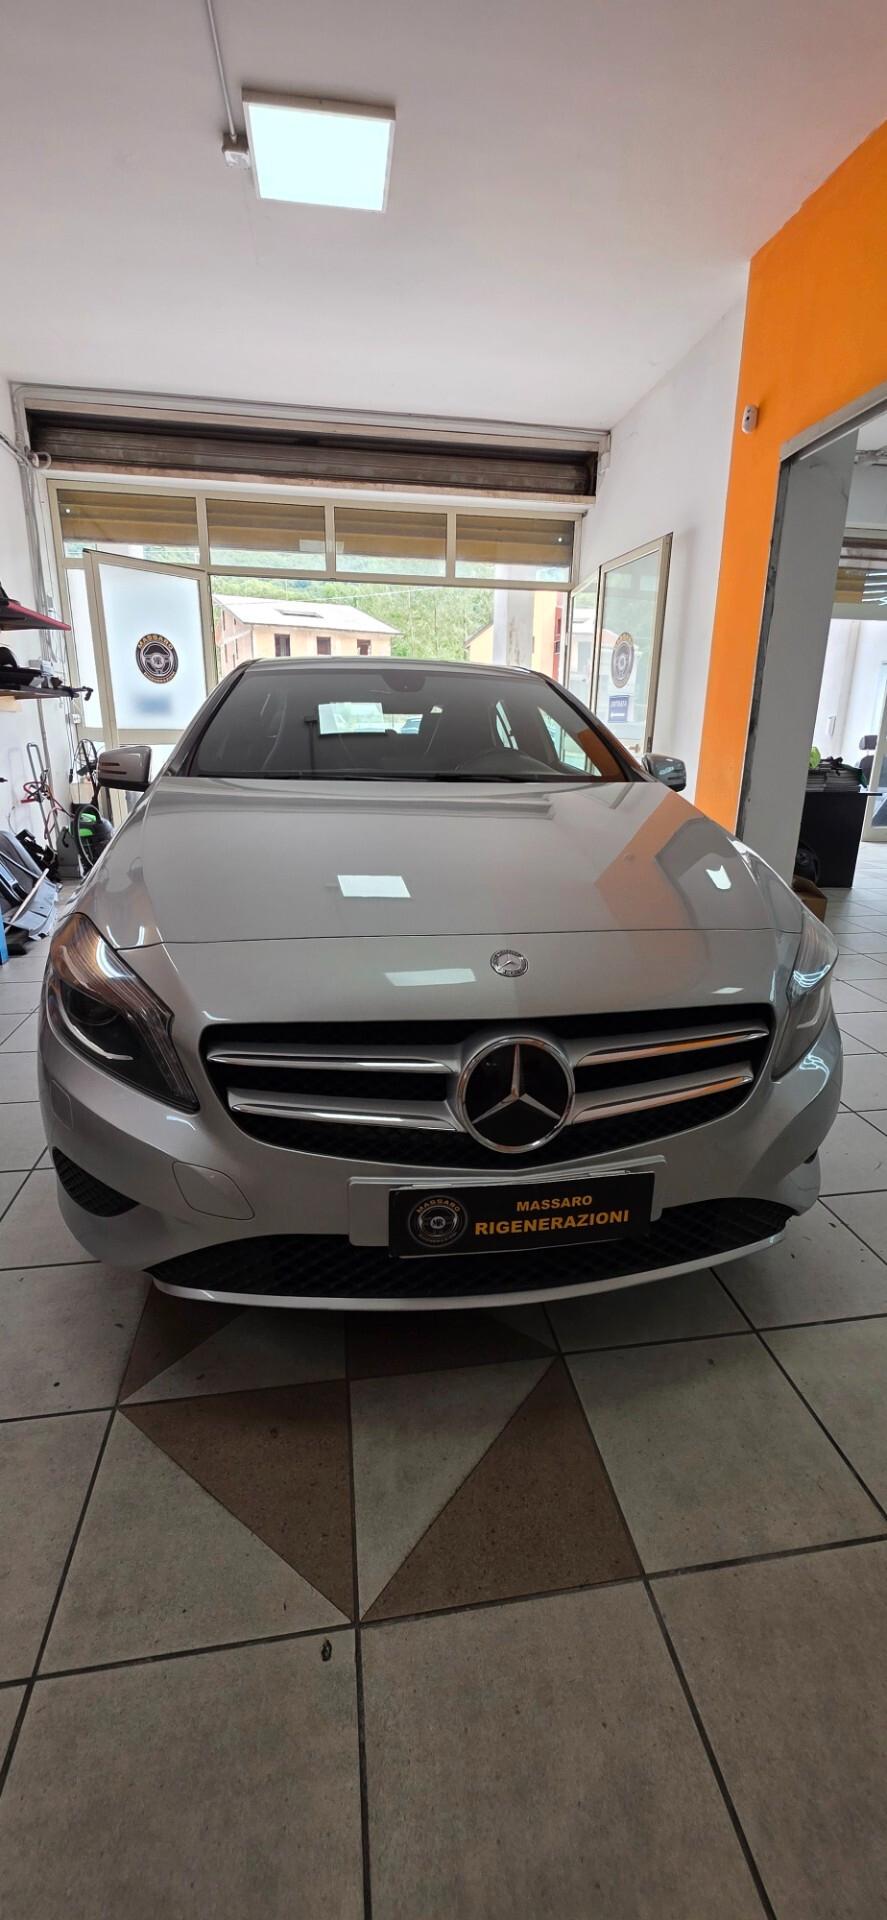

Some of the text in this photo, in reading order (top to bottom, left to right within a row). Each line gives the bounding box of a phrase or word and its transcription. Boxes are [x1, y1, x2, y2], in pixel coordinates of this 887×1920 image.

[416, 1199, 461, 1213] MASSARO
[516, 1195, 593, 1212] MASSARO
[474, 1210, 630, 1236] RIGENERAZIONI
